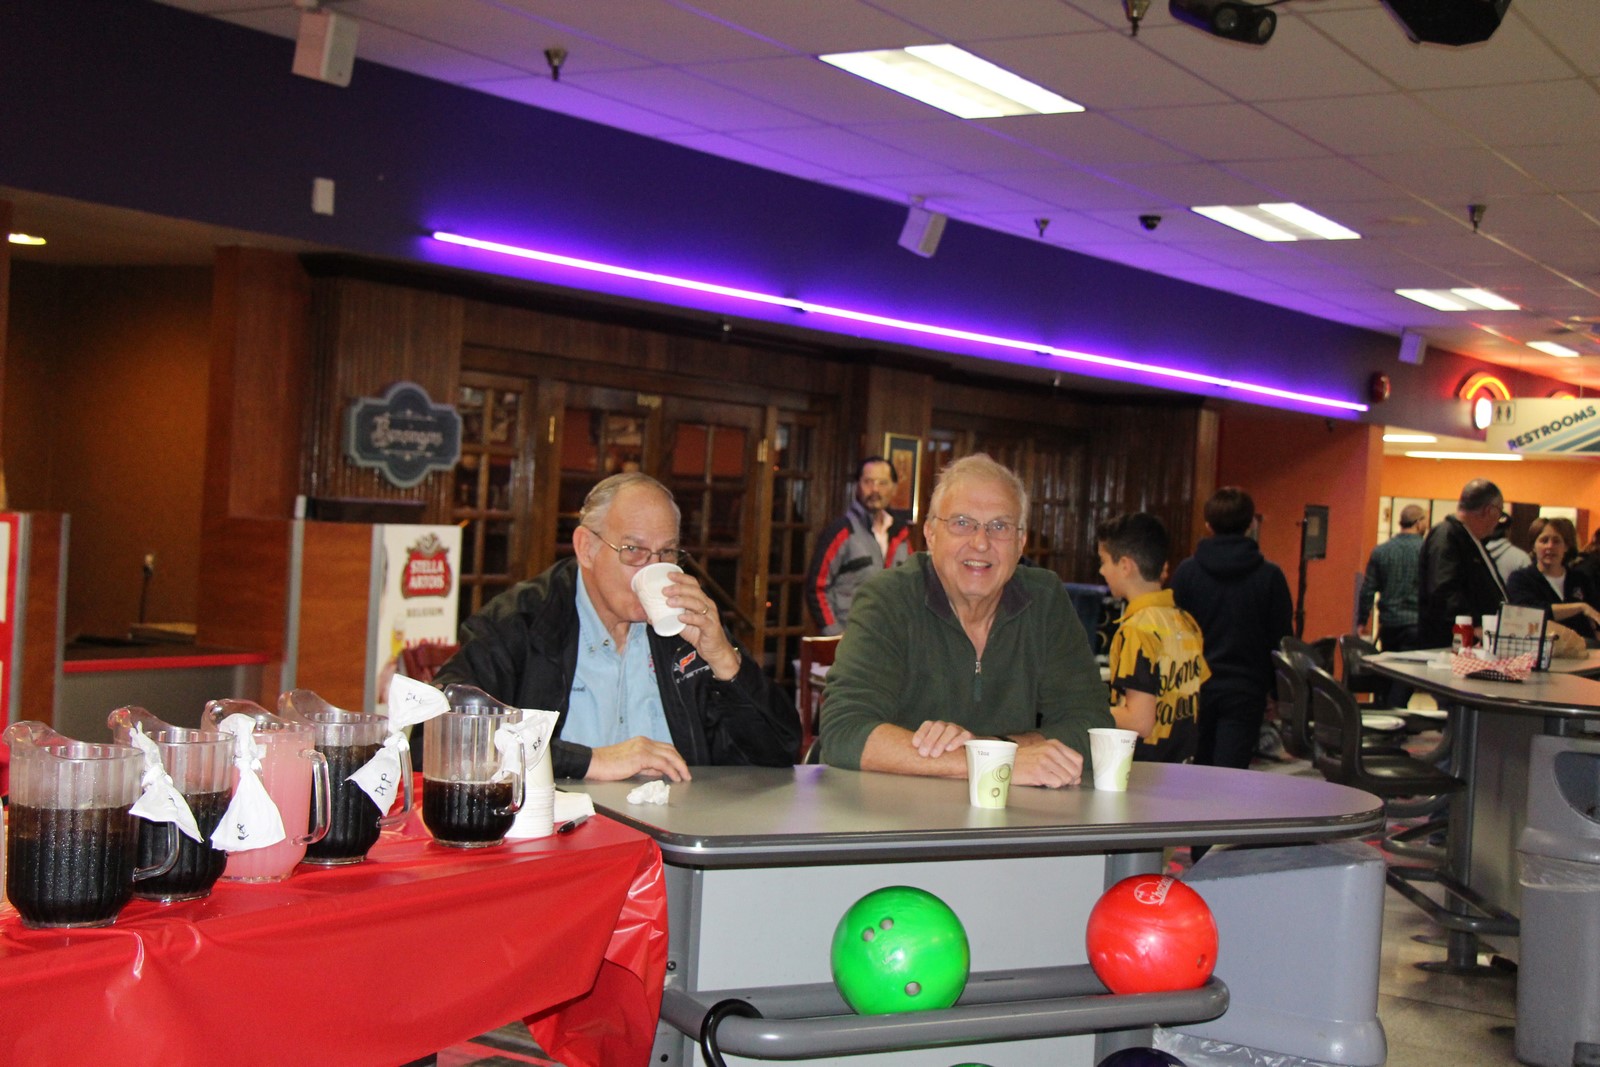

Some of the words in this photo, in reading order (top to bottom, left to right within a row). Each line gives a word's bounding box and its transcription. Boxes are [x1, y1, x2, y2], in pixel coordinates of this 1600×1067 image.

[1507, 405, 1597, 450] RESTROOMS
[410, 560, 446, 574] STELLA
[409, 575, 446, 589] ARTOIS
